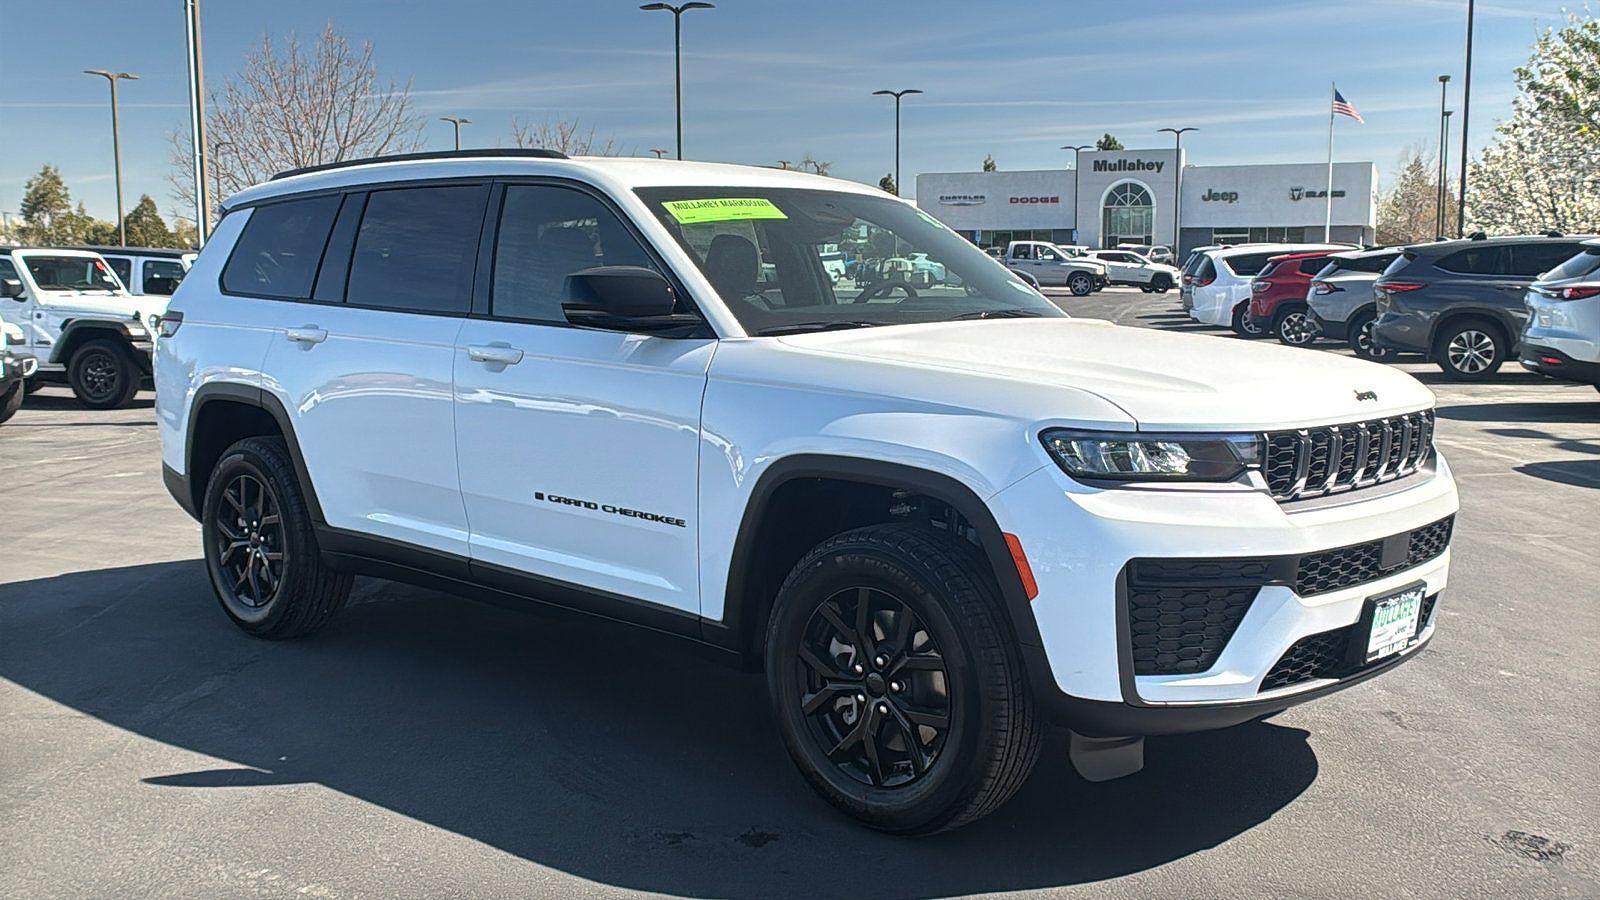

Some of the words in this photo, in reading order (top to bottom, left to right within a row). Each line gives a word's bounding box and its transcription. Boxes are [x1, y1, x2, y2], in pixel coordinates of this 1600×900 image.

[1093, 159, 1165, 173] Mullahey
[1009, 196, 1059, 204] DODGE
[1201, 188, 1239, 203] Jeep
[671, 200, 719, 210] MULLAHEY
[720, 199, 771, 208] MARKDOWN
[547, 494, 599, 510] GRAND
[601, 504, 687, 528] CHEROKEE
